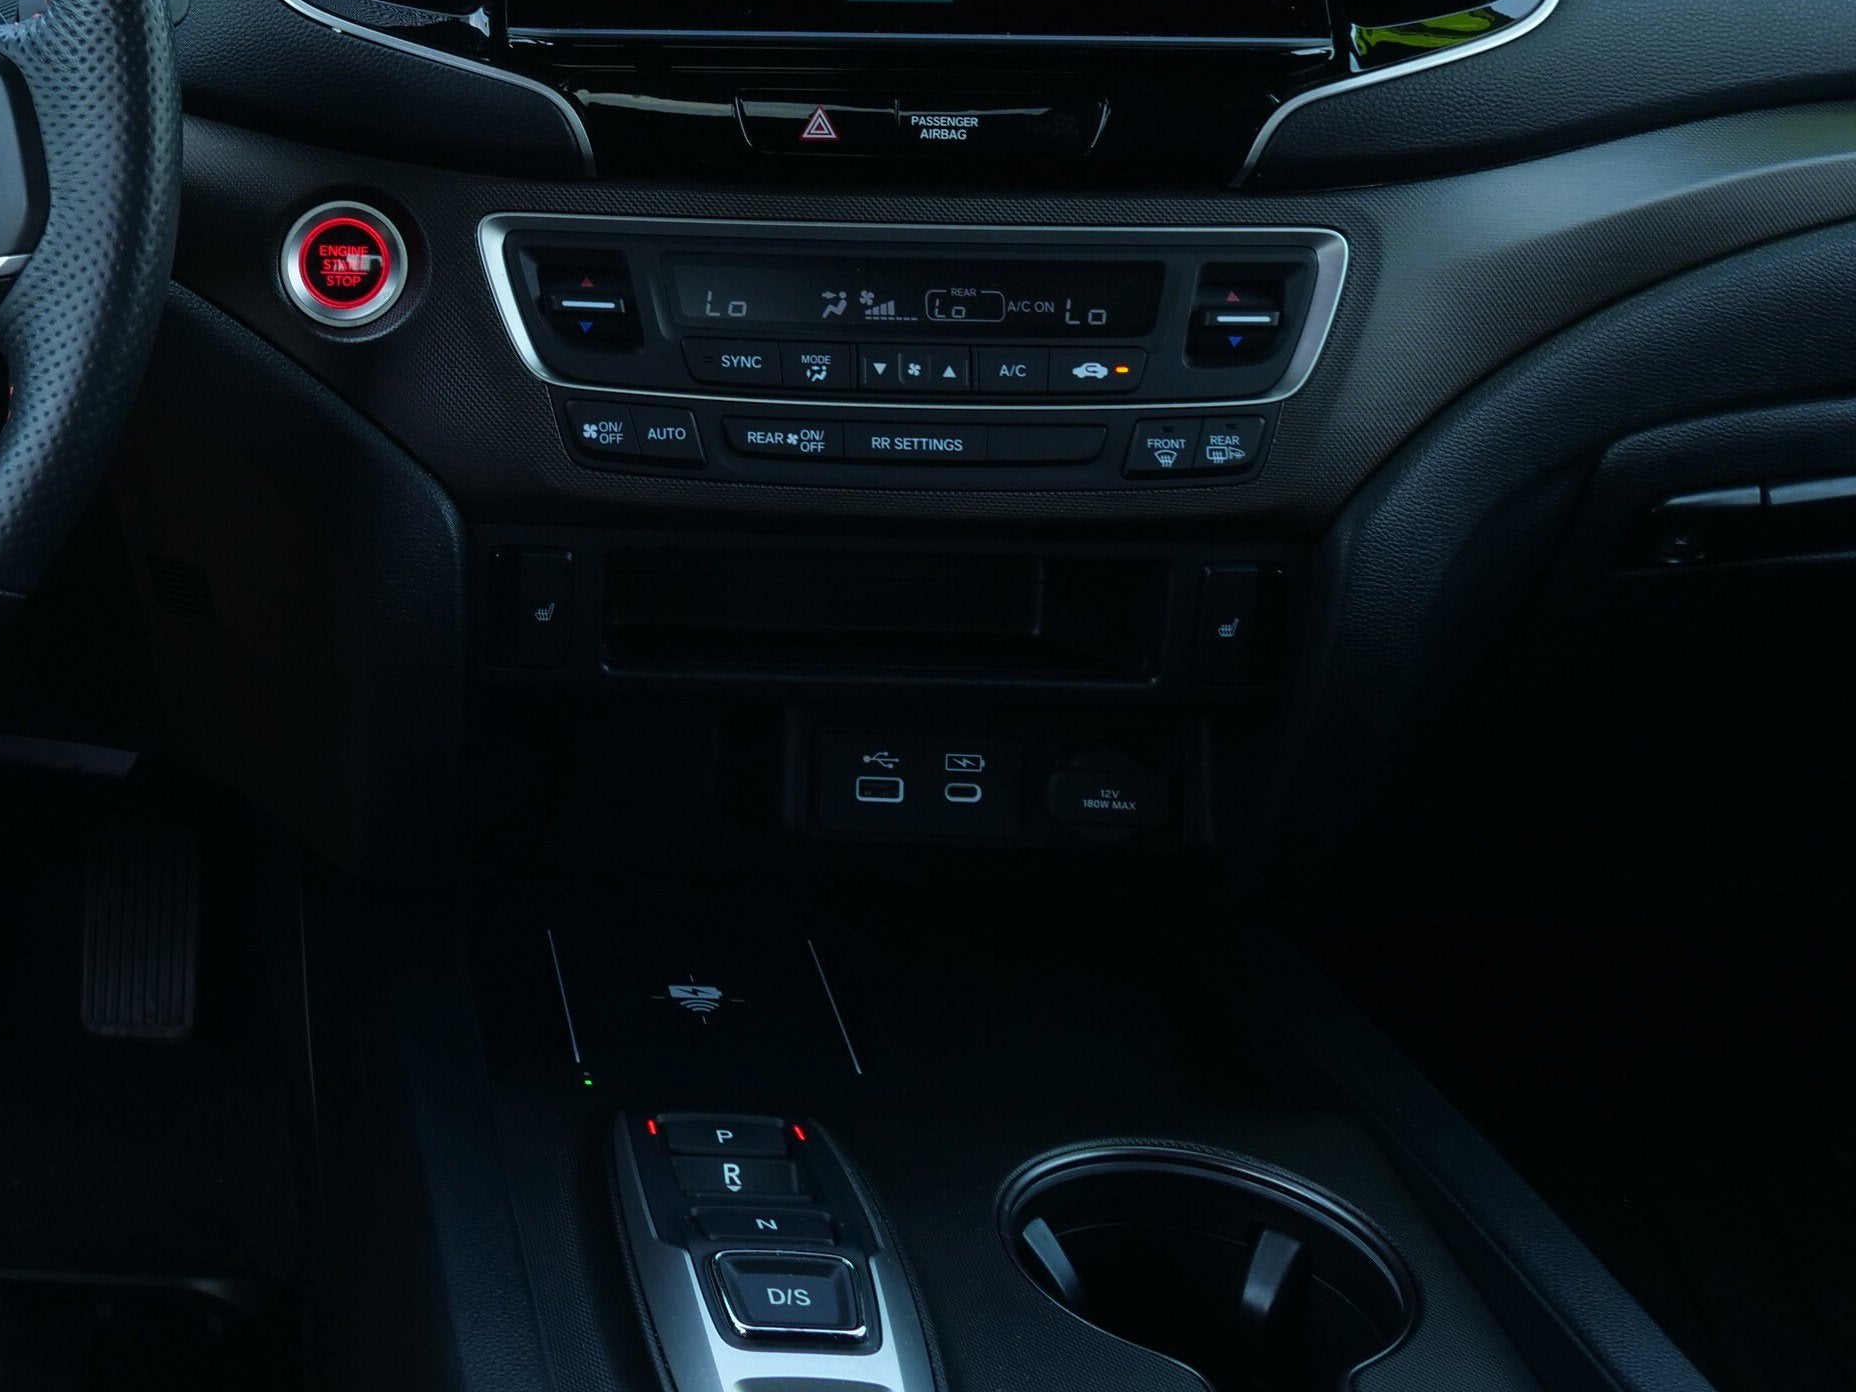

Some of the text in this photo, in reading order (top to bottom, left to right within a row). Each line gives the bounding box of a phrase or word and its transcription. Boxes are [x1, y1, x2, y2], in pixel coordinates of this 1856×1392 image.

[911, 116, 979, 128] PASSENGER
[920, 128, 967, 141] AIRBAG
[319, 244, 369, 256] ENGINE
[326, 275, 362, 287] STOP
[950, 288, 977, 298] REAR
[1007, 301, 1055, 314] A/C ON
[721, 354, 763, 370] SYNC
[801, 354, 832, 365] MODE
[999, 364, 1026, 378] A/C
[599, 432, 624, 445] OFF
[647, 427, 687, 441] AUTO
[747, 431, 784, 445] REAR
[800, 441, 826, 453] OFF
[871, 436, 963, 452] RR SETTINGS
[1147, 438, 1186, 450] FRONT
[1209, 435, 1240, 447] REAR
[1100, 789, 1120, 799] 12V
[1082, 799, 1137, 812] 180W MAX
[716, 1129, 733, 1144] P
[723, 1163, 742, 1186] R
[755, 1218, 778, 1231] N
[767, 1287, 812, 1306] D/S
